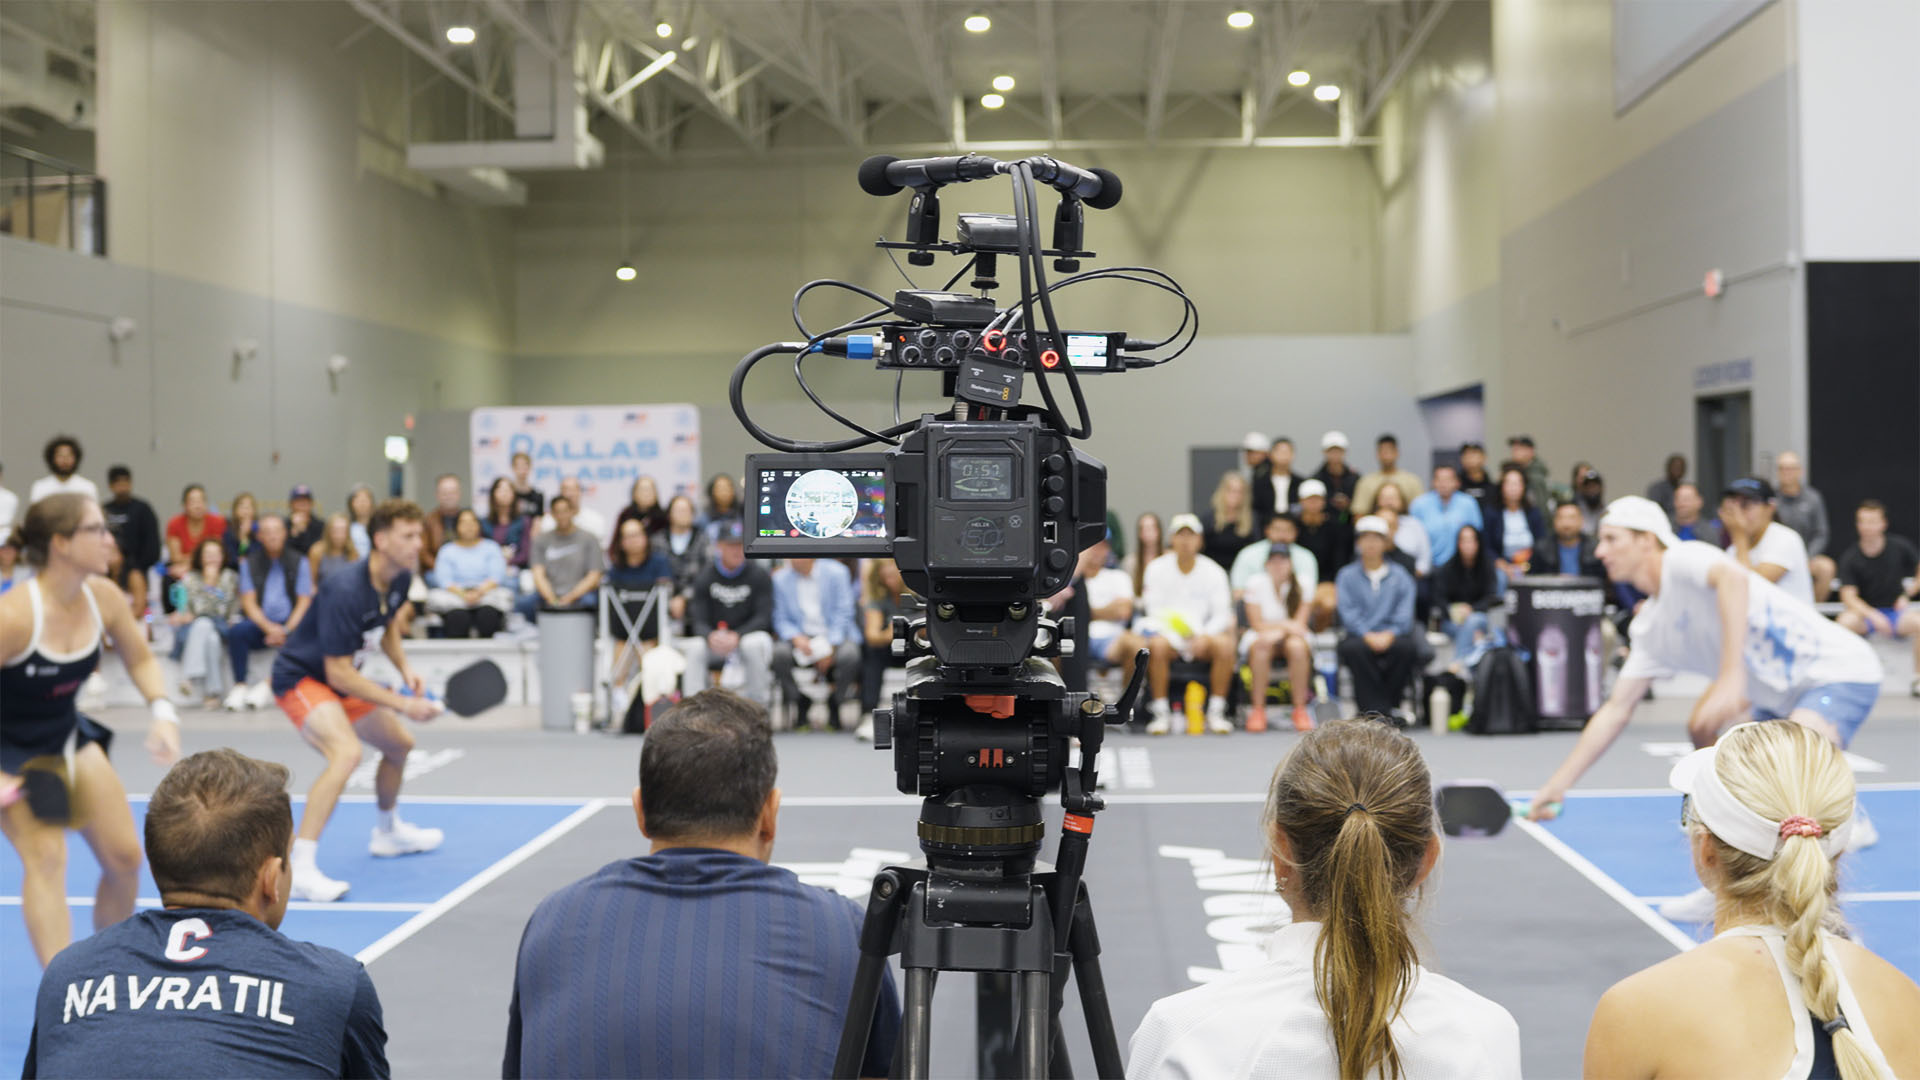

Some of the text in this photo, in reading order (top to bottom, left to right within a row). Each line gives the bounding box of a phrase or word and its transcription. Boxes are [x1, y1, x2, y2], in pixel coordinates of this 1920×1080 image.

[510, 433, 659, 460] DALLAS
[164, 917, 213, 963] C
[63, 974, 295, 1026] NAVRATIL
